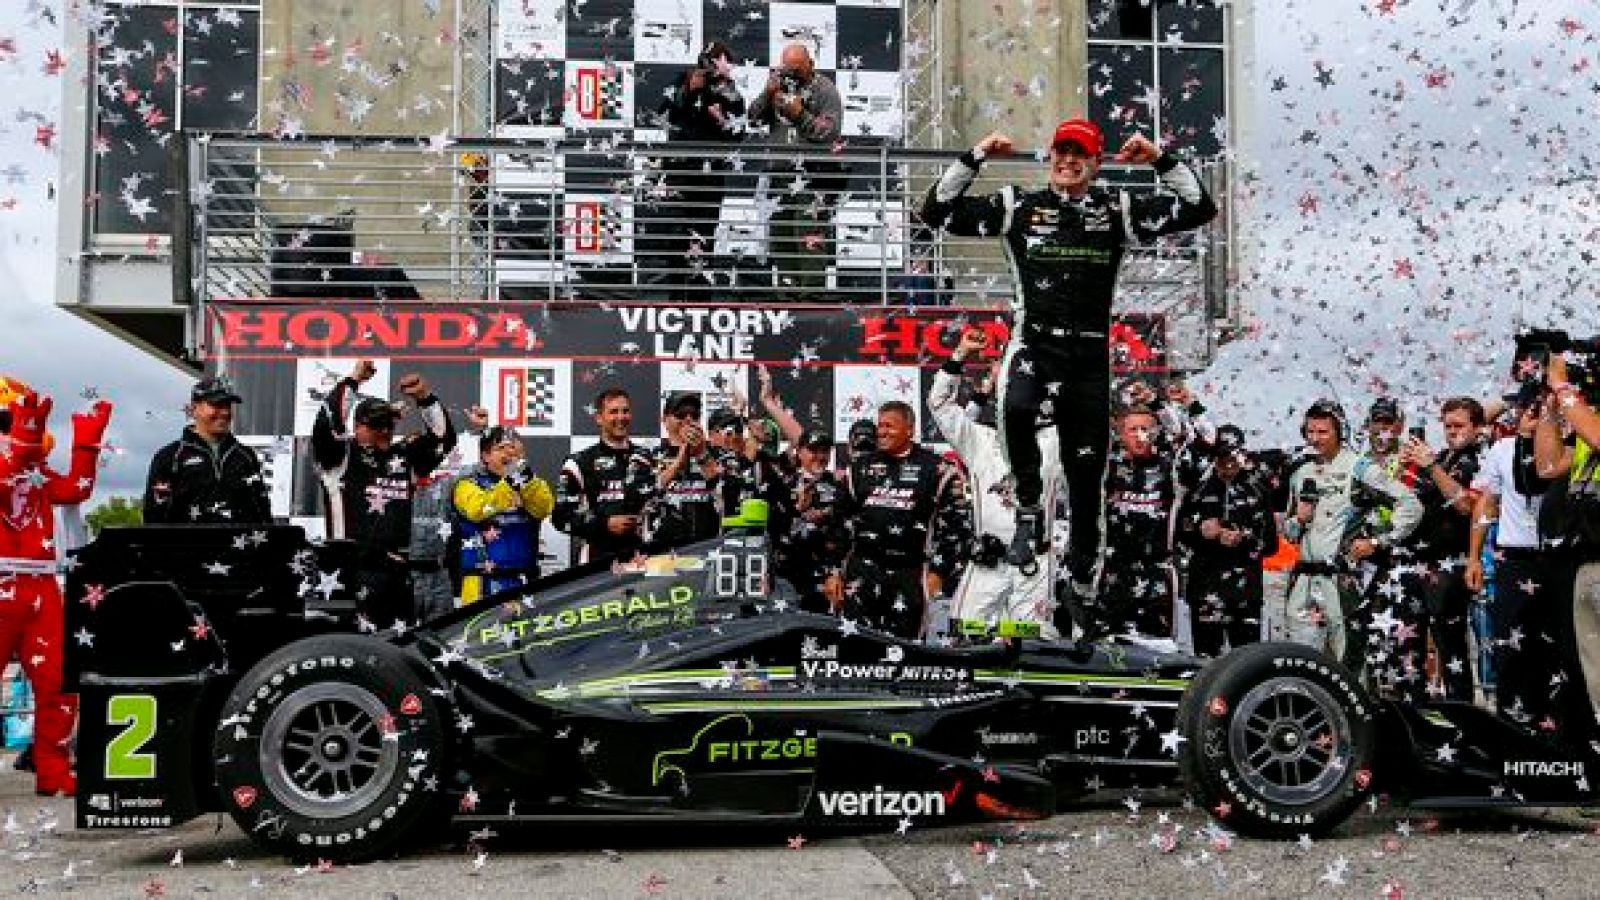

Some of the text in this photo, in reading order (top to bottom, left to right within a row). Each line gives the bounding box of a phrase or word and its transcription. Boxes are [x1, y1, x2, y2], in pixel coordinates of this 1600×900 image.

[220, 312, 544, 348] HONDA
[619, 308, 787, 333] VICTORY
[654, 335, 755, 360] LANE
[480, 585, 694, 644] FITZGERALD
[802, 660, 897, 680] V-Power
[105, 694, 158, 779] 2
[1503, 761, 1585, 777] HITACHI
[818, 786, 946, 817] verizon
[86, 814, 170, 828] Firestone
